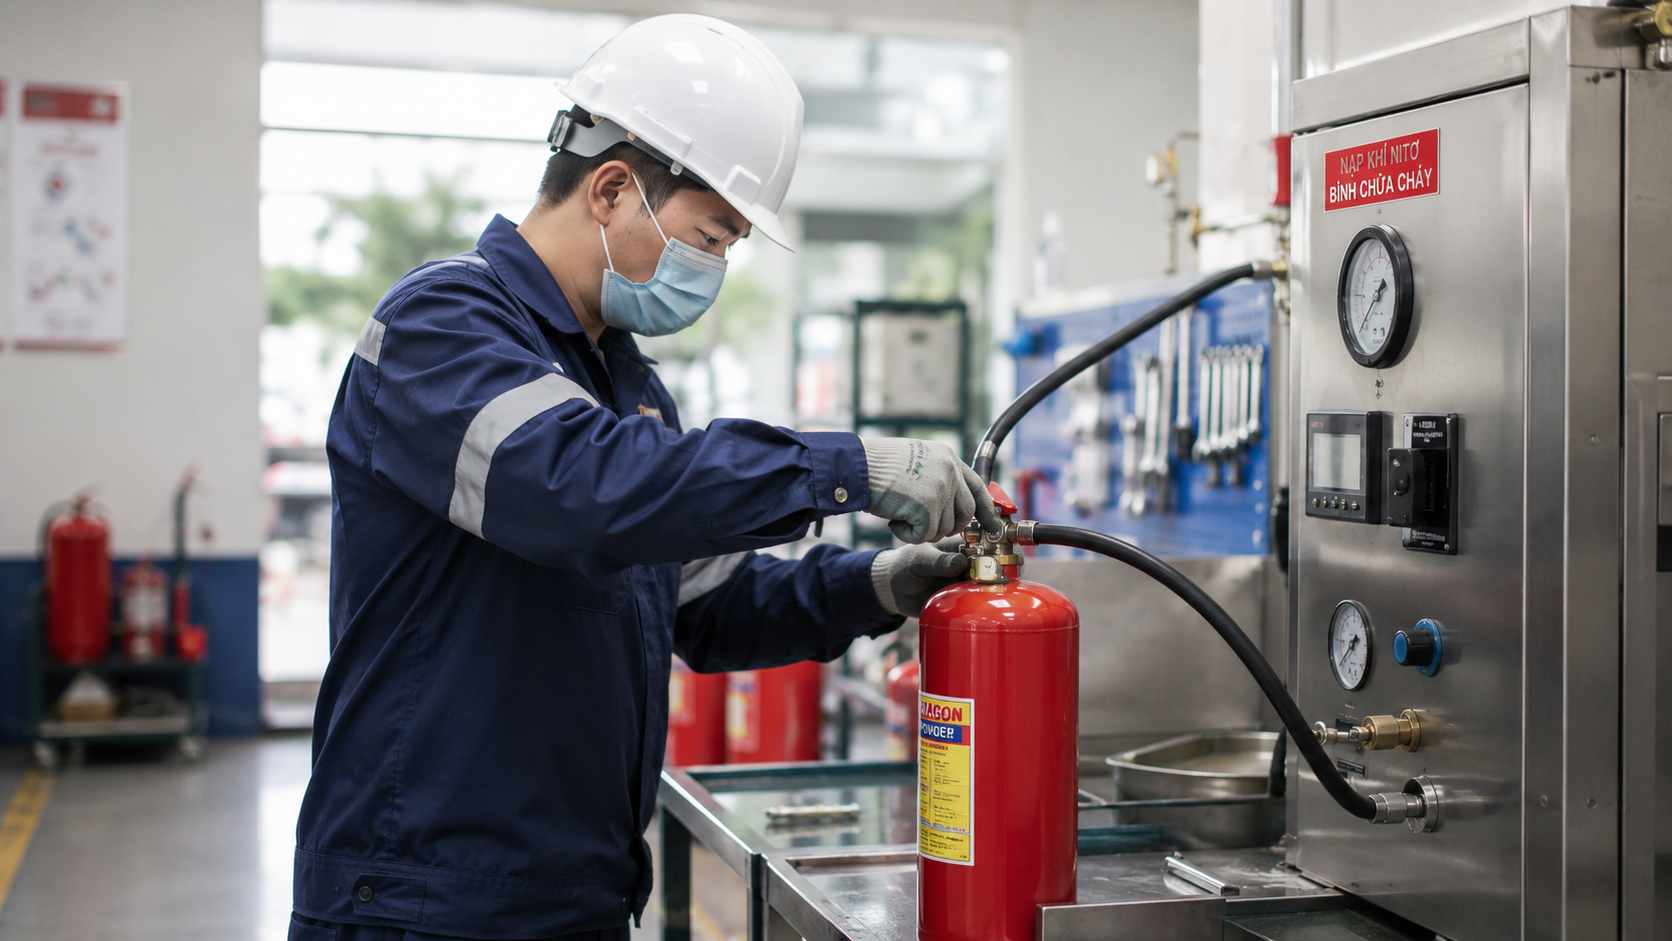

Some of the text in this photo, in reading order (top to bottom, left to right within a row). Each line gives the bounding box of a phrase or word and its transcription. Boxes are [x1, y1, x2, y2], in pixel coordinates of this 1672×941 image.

[1340, 139, 1420, 178] NẠP KHÍ NITƠ
[1397, 164, 1433, 192] CHÁY
